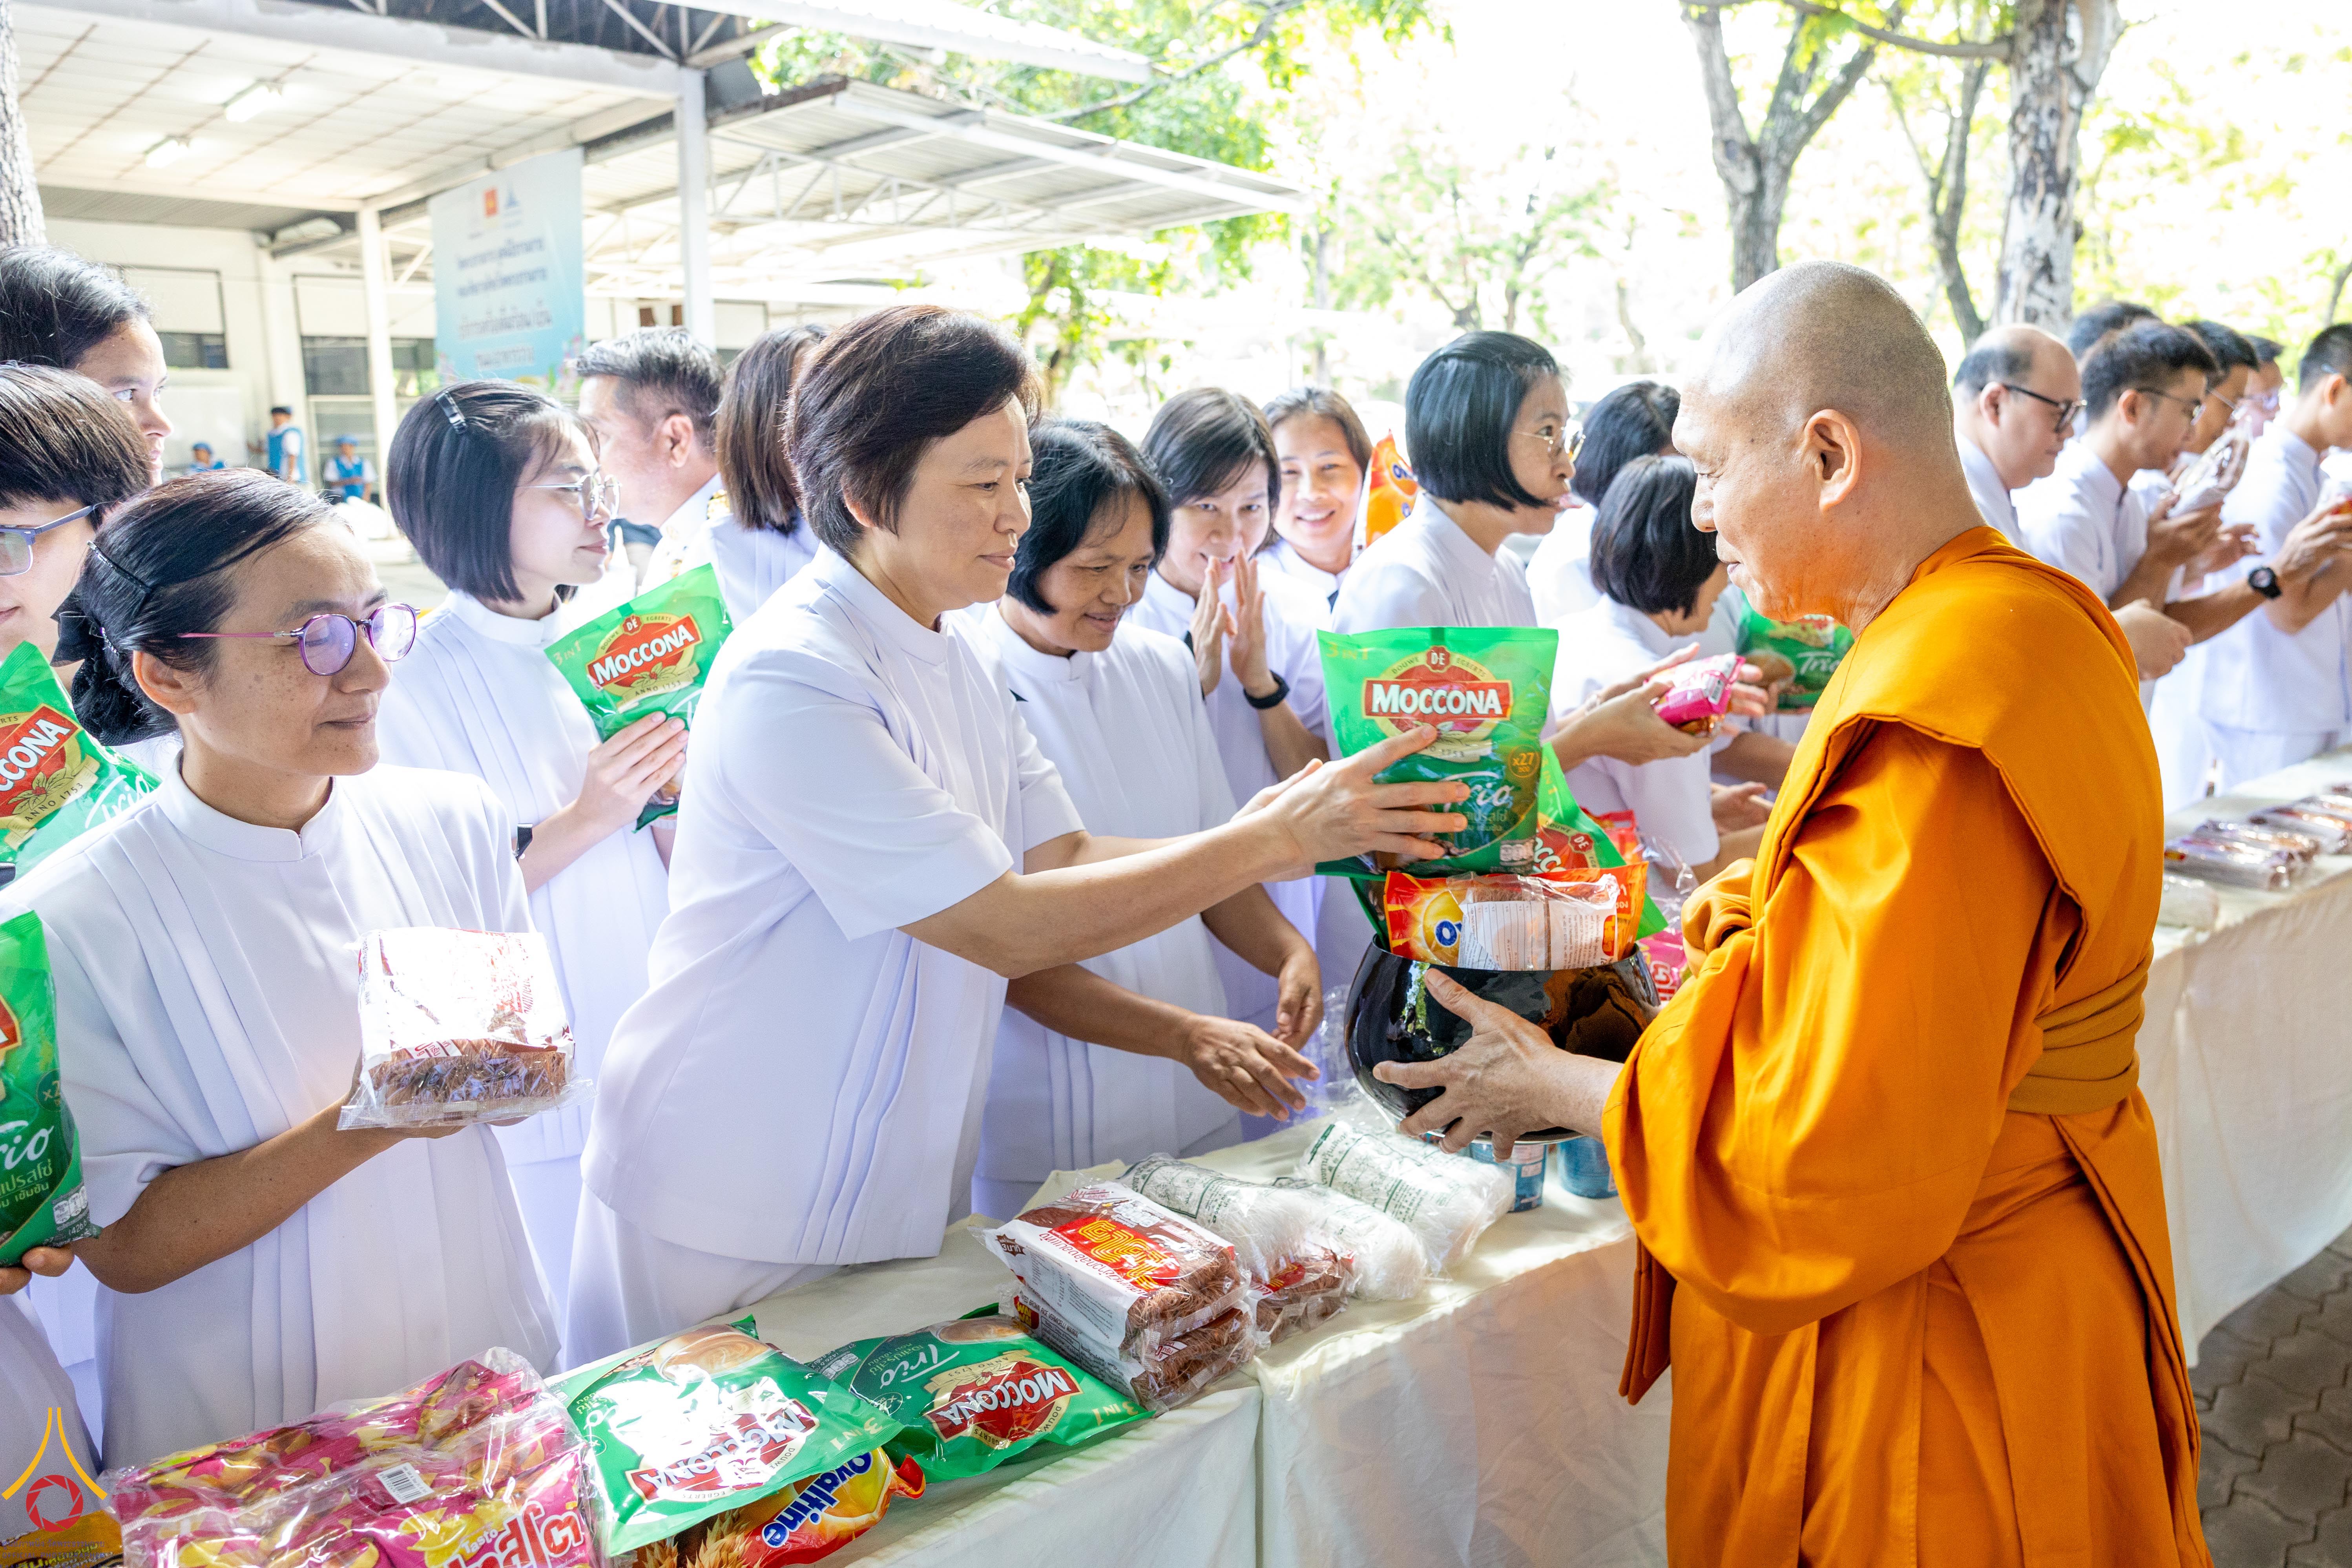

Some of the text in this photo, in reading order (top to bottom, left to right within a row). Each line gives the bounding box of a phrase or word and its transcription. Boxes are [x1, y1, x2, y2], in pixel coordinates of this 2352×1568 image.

[553, 639, 581, 666] 3 IN 1
[601, 630, 619, 650] DOUWE
[1326, 643, 1338, 658] 3
[1342, 649, 1359, 660] IN
[592, 624, 695, 685] MOCCONA
[1391, 655, 1487, 677] DOUWE EGBERTS
[634, 680, 681, 696] ANNO 1753
[1371, 683, 1503, 715] MOCCONA
[24, 782, 84, 822] ANNO 1753
[1574, 836, 1589, 849] DE
[869, 1345, 924, 1375] เอสเปรสโซ่
[880, 1344, 960, 1389] Trio
[947, 1356, 1008, 1377] ANNO 1753
[935, 1371, 1071, 1426] MOCCONA
[1092, 1401, 1136, 1426] 3 IN 1
[830, 1416, 883, 1451] 3 IN 1
[683, 1448, 796, 1499] DOUWE EGBERTS
[762, 1451, 874, 1548] Ovaltine
[461, 1529, 498, 1554] Tasto
